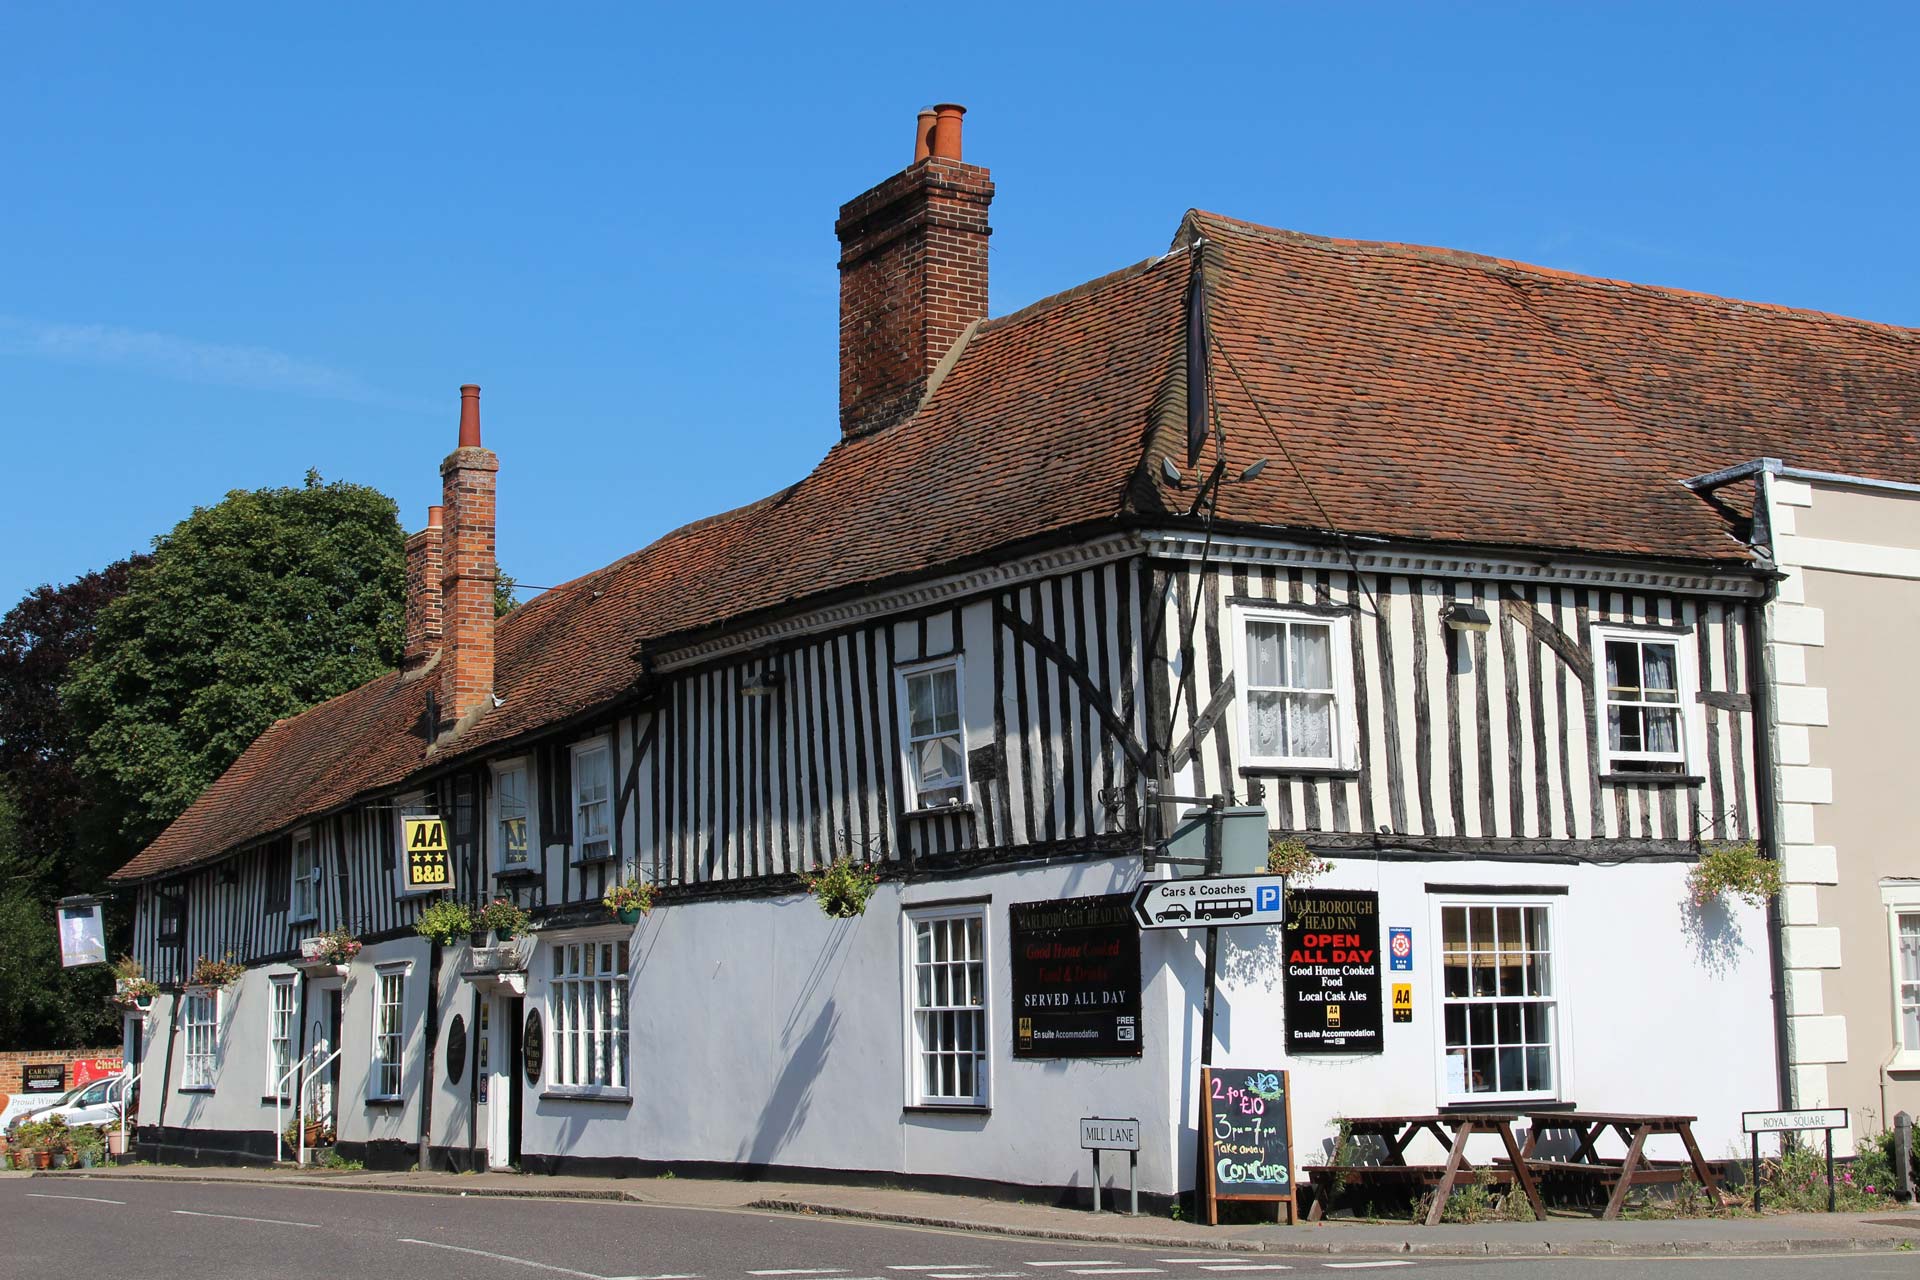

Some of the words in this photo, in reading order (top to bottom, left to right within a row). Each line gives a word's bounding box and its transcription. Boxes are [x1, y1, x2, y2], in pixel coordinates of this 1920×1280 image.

[412, 823, 442, 847] AA
[412, 864, 445, 883] B&B
[1161, 886, 1186, 897] Cars
[1188, 886, 1196, 896] &
[1200, 884, 1246, 896] Coaches
[1262, 889, 1276, 909] P
[1288, 900, 1373, 915] MARLBOROUGH
[1305, 916, 1335, 930] HEAD
[1338, 916, 1357, 929] INN
[1304, 934, 1360, 947] OPEN
[1290, 950, 1328, 963] ALL
[1333, 950, 1374, 963] DAY
[1290, 966, 1312, 976] Good
[1315, 965, 1340, 976] Home
[1342, 964, 1374, 976] Cooked
[1322, 976, 1342, 986] Food
[1024, 994, 1069, 1007] SERVED
[1074, 992, 1097, 1005] ALL
[1103, 990, 1126, 1004] DAY
[1298, 990, 1322, 1002] Local
[1324, 990, 1346, 1002] Cask
[1348, 990, 1367, 1001] Ales
[1395, 990, 1410, 1004] AA
[1329, 1006, 1338, 1014] AA
[1116, 1016, 1134, 1024] FREE
[1034, 1030, 1041, 1038] En
[1041, 1030, 1054, 1038] suite
[1055, 1030, 1099, 1038] Accommodation
[1294, 1030, 1303, 1038] En
[1304, 1030, 1320, 1038] suite
[1322, 1029, 1376, 1038] Accommodation
[1211, 1078, 1224, 1099] 2
[1226, 1087, 1245, 1104] for
[12, 1098, 35, 1106] Proud
[1240, 1096, 1264, 1114] £10
[1763, 1117, 1788, 1128] ROYAL
[1794, 1116, 1826, 1127] SQUARE
[1086, 1127, 1106, 1141] MILL
[1110, 1128, 1134, 1142] LANE
[1214, 1140, 1238, 1156] Take
[1239, 1146, 1265, 1163] away
